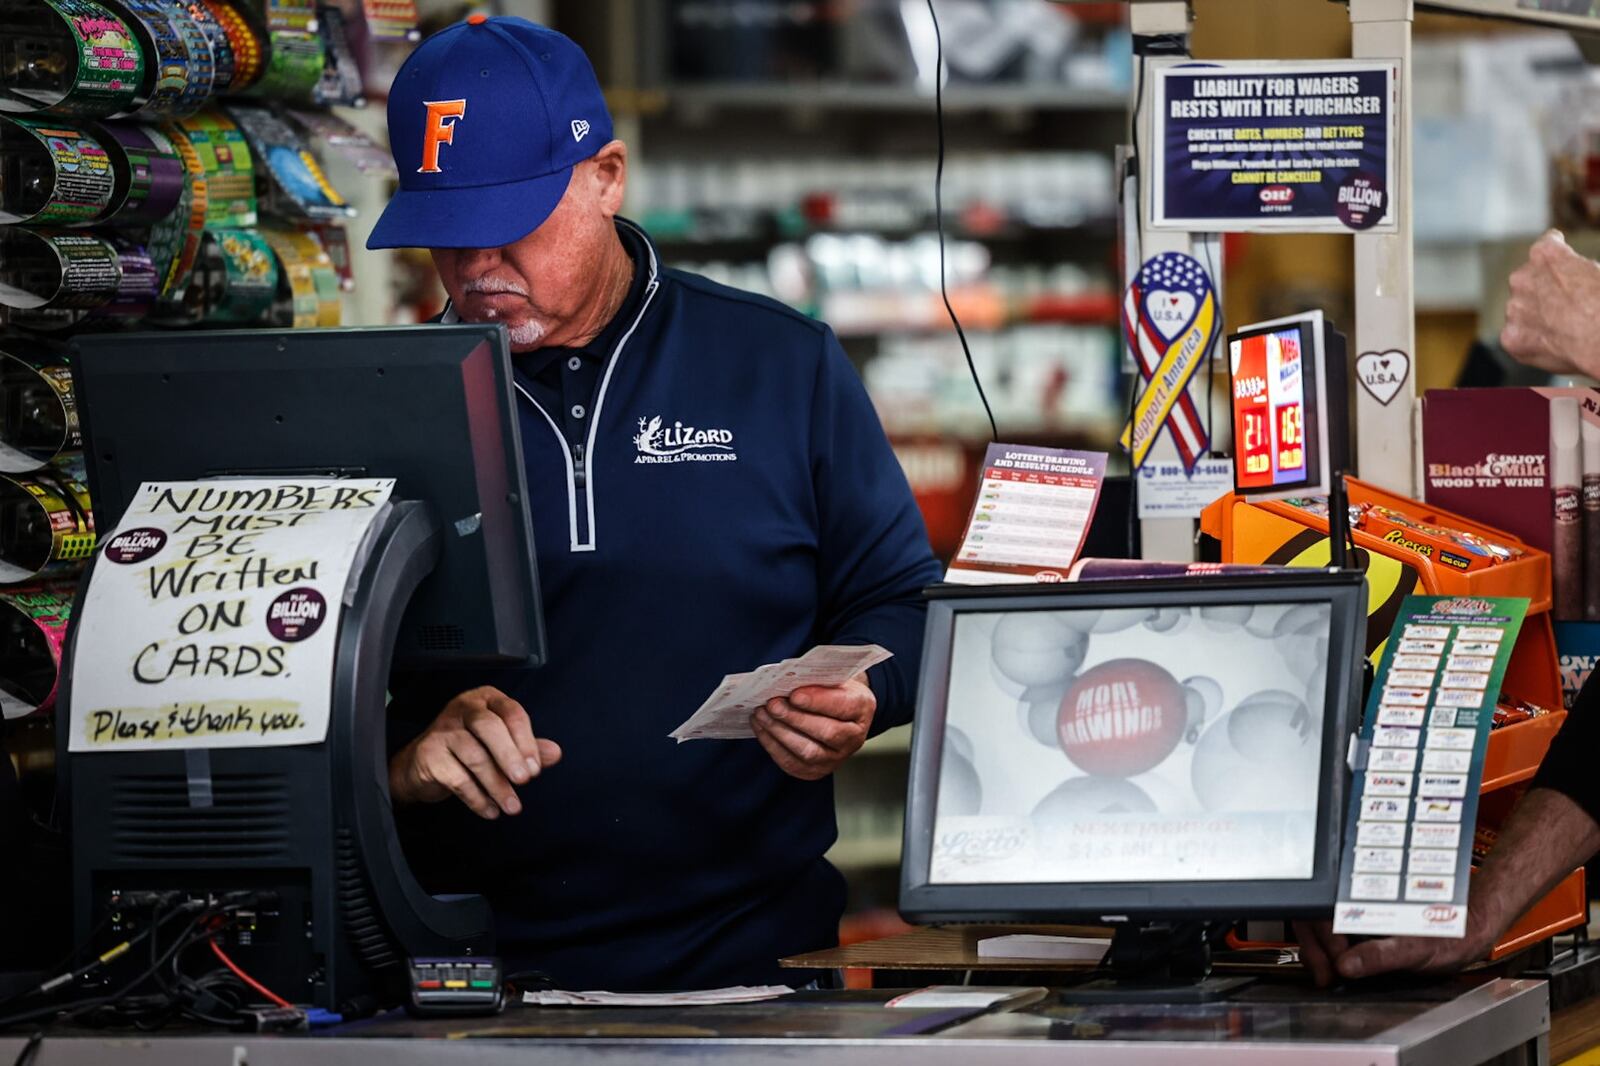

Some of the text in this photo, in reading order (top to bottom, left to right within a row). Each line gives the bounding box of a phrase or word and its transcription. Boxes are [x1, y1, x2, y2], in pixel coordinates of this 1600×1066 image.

[1193, 77, 1359, 97] LIABILITY FOR WAGERS
[1171, 97, 1381, 117] RESTS WITH THE PURCHASER
[417, 98, 467, 173] F
[1187, 128, 1217, 141] CHECK
[1218, 128, 1233, 140] THE
[1305, 127, 1322, 139] AND
[1322, 126, 1338, 138] BET
[1338, 125, 1364, 138] TYPES
[1338, 186, 1382, 208] BILLION
[1163, 329, 1202, 394] America
[994, 459, 1094, 475] AND RESULTS SCHEDULE
[1005, 452, 1086, 466] LOTTERY DRAWING
[1429, 462, 1484, 477] Black
[1502, 463, 1546, 477] Mild
[1431, 479, 1544, 488] WOOD TIP WINE
[173, 511, 325, 534] MUST
[111, 536, 161, 549] BILLION
[184, 532, 264, 559] BE
[1440, 555, 1453, 564] BIG
[1453, 560, 1468, 568] CUP
[177, 599, 246, 635] ON
[271, 601, 321, 619] BILLION
[1076, 681, 1141, 720] MORE
[1072, 822, 1130, 836] NEXT
